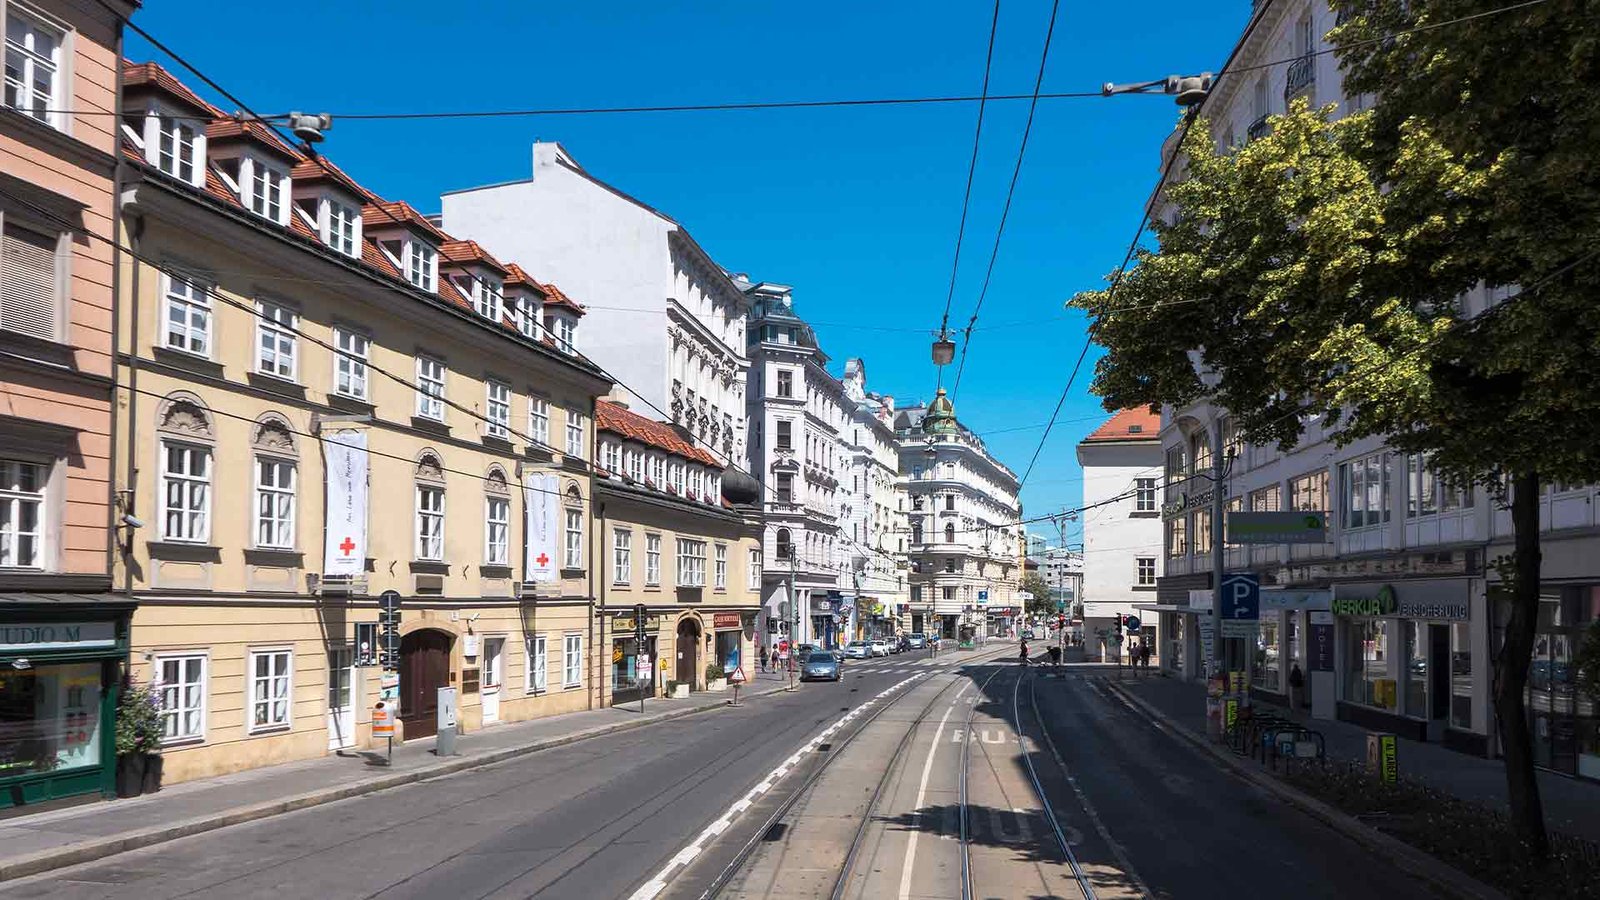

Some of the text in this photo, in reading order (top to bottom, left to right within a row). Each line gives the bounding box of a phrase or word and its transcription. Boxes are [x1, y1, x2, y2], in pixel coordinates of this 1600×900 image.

[1233, 583, 1251, 605] P
[1332, 599, 1467, 618] MERKUR VERSICHERUNG
[1317, 626, 1329, 670] HOTEL
